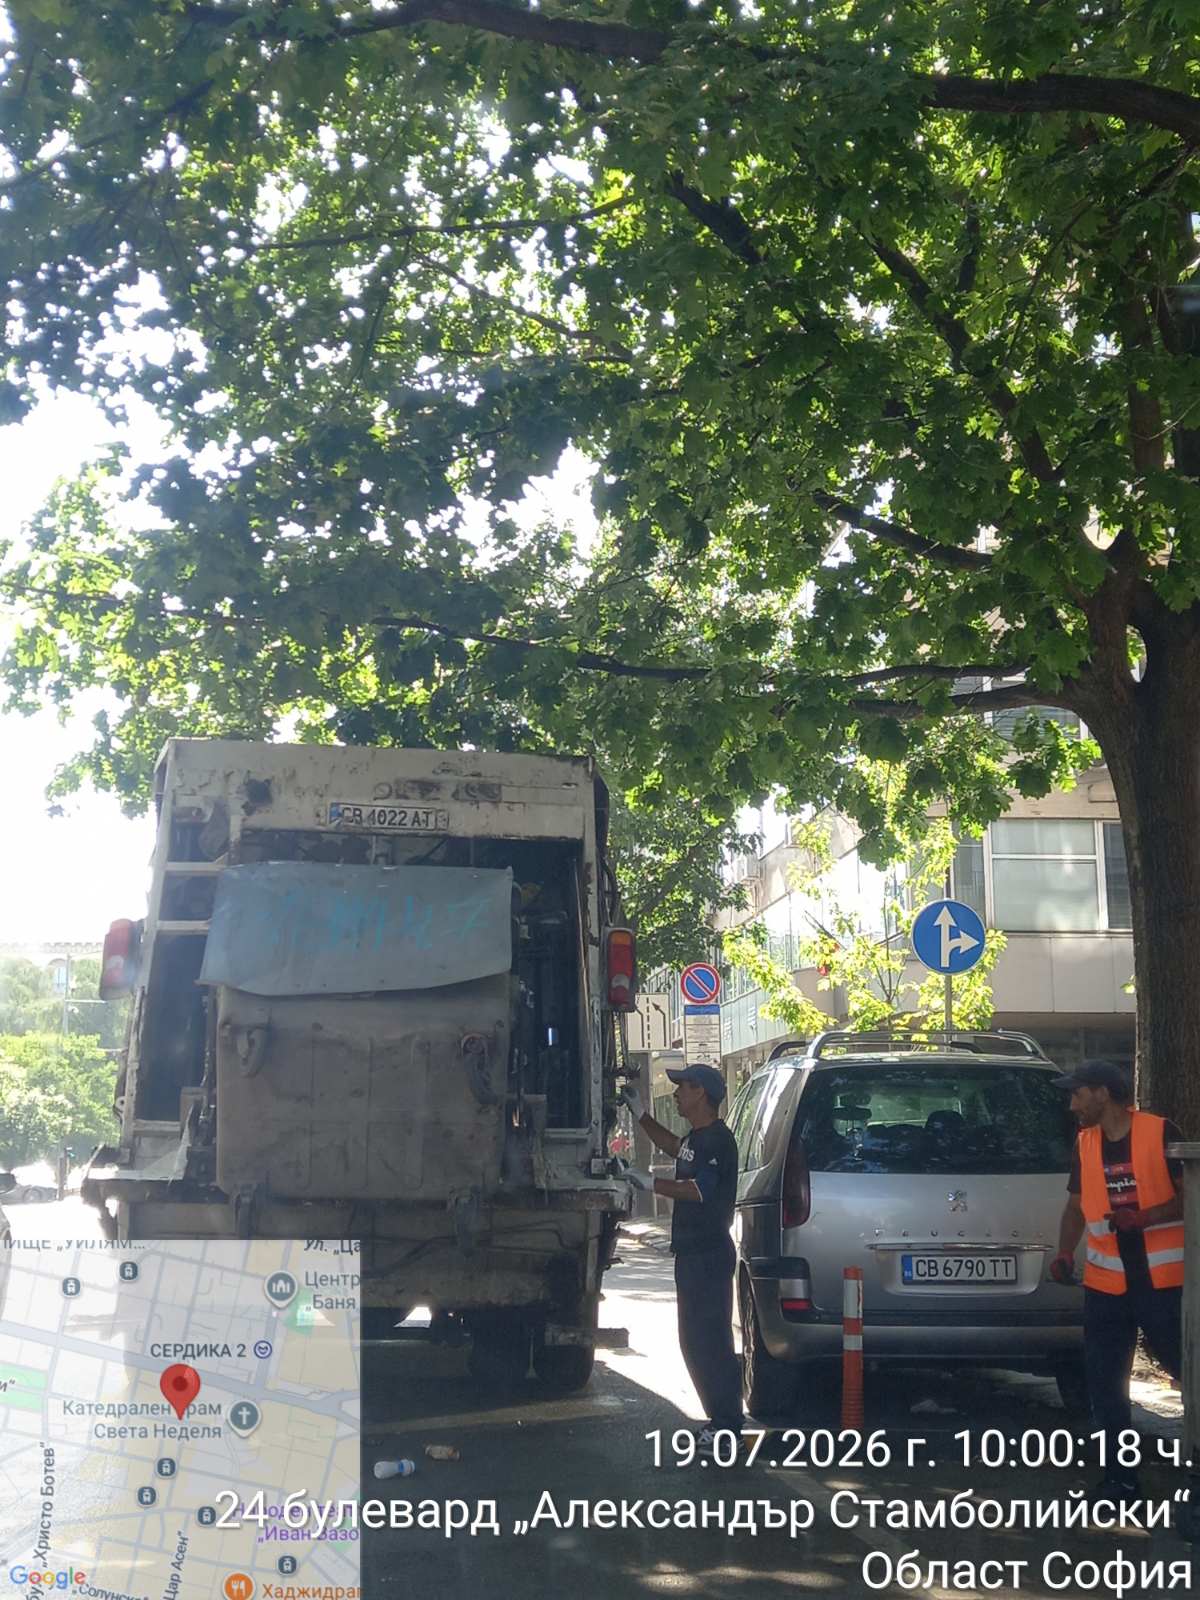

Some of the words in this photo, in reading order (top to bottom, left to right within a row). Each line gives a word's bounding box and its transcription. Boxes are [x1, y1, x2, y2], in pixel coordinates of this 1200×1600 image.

[915, 1259, 938, 1277] CB
[943, 1259, 985, 1277] 6790
[990, 1260, 1012, 1276] TT
